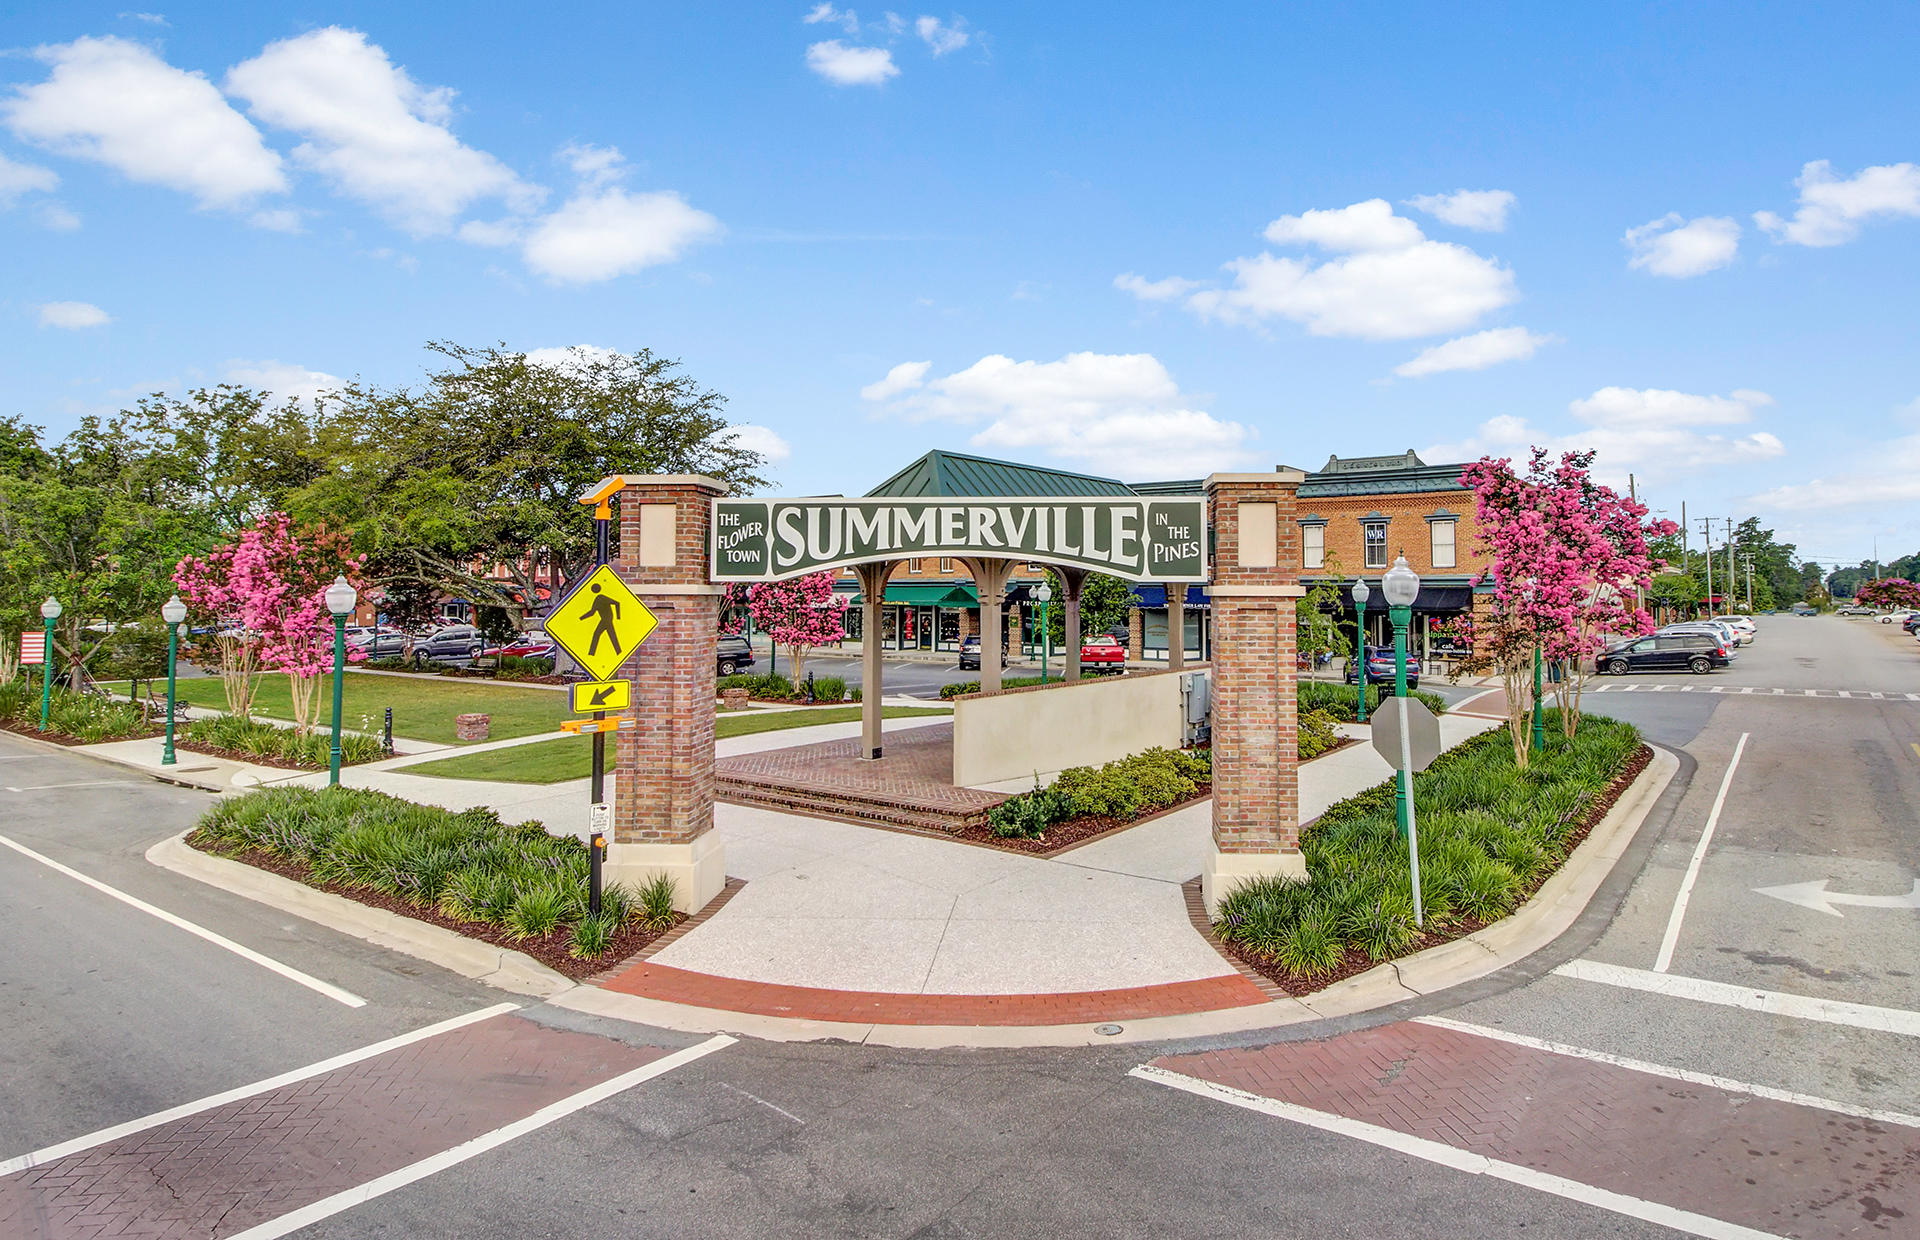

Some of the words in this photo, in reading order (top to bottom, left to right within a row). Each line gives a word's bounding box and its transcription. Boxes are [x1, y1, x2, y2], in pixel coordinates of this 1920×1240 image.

[719, 513, 740, 526] THE
[1155, 513, 1168, 525] IN
[718, 522, 763, 549] FLOWER
[776, 506, 1139, 568] SUMMERVILLE
[1167, 526, 1190, 539] THE
[1367, 530, 1384, 539] WR
[726, 550, 760, 562] TOWN
[1154, 541, 1199, 563] PINES
